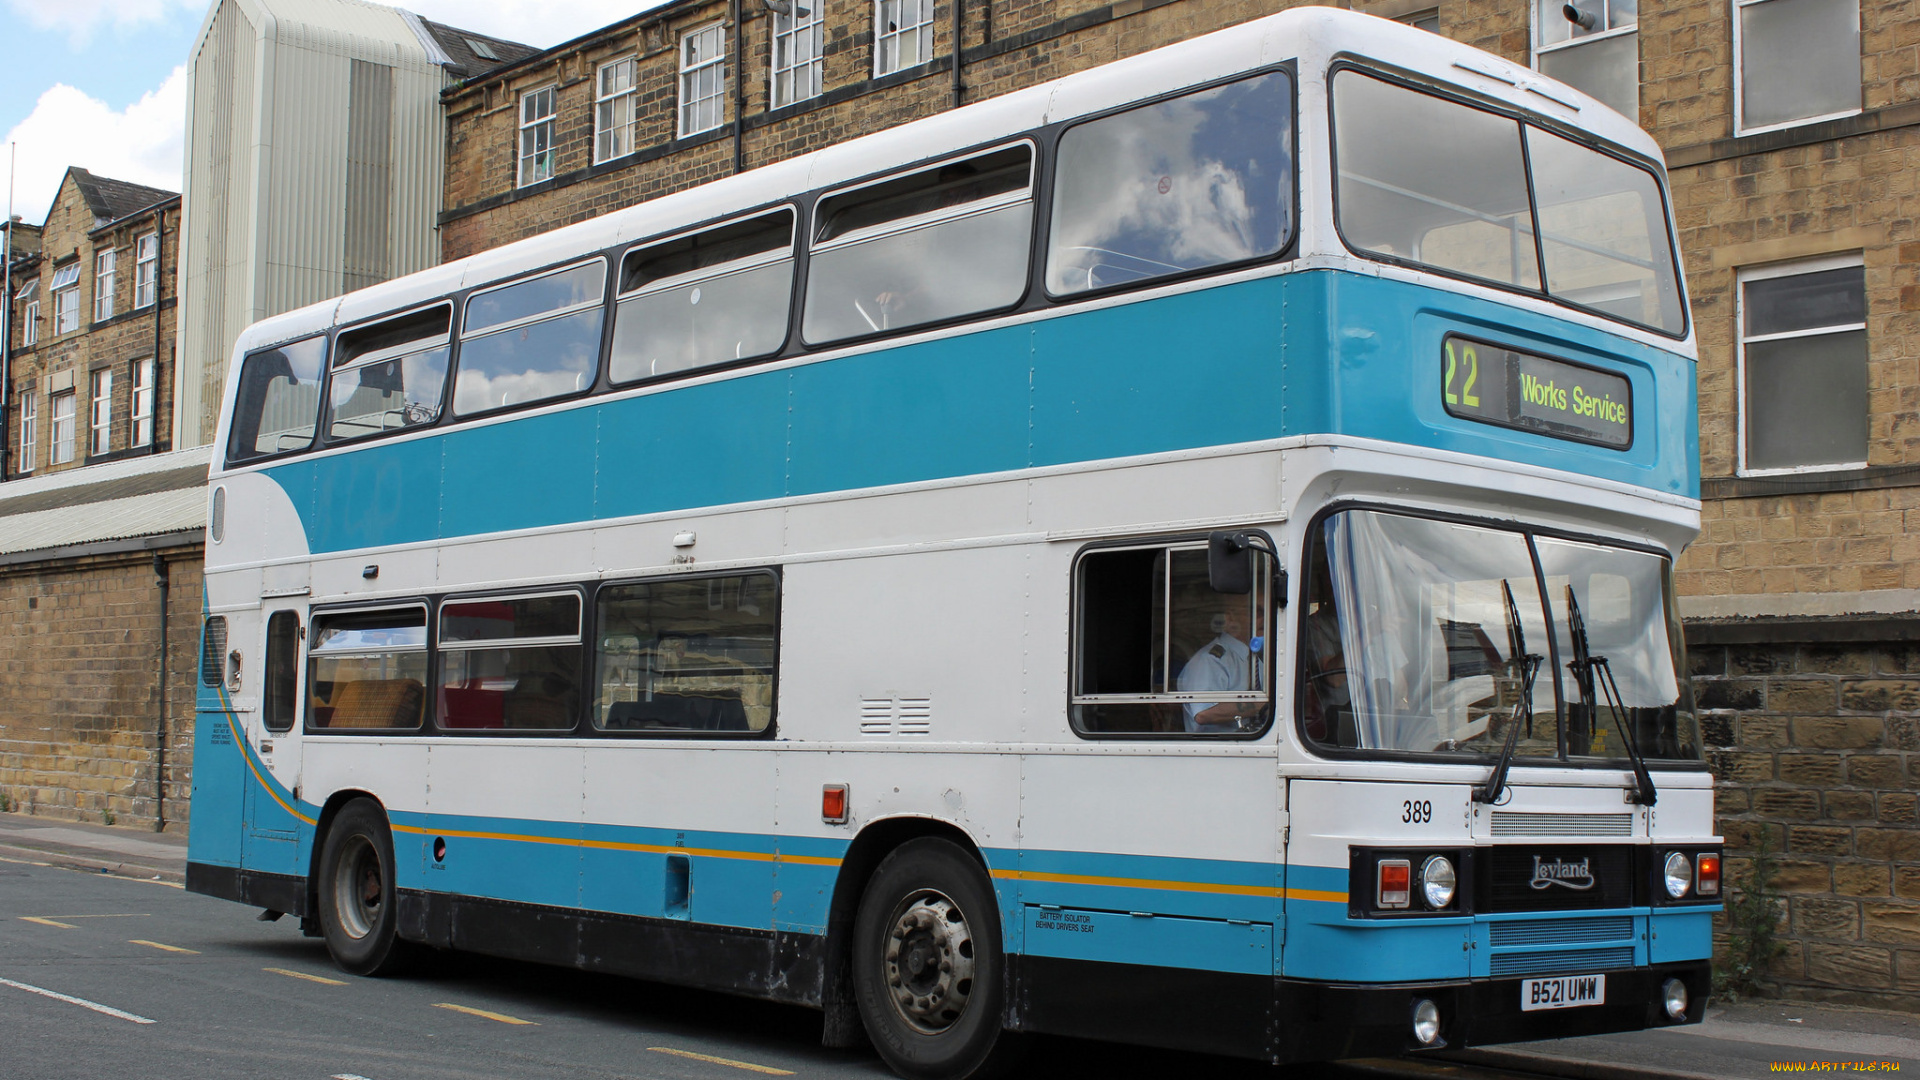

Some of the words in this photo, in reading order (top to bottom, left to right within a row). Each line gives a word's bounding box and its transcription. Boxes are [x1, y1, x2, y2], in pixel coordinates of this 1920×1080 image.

[1445, 341, 1480, 407] 22
[1520, 373, 1567, 410] Works
[1572, 385, 1626, 424] Service
[1402, 800, 1432, 823] 389
[1530, 855, 1594, 889] Leyland
[1035, 921, 1055, 929] BEHIND
[1056, 922, 1079, 932] DRIVERS
[1081, 924, 1095, 933] SEAT
[1039, 912, 1062, 921] BATTERY
[1064, 914, 1091, 923] ISOLATOR
[1531, 980, 1565, 1004] B521
[1568, 977, 1597, 1001] UWW
